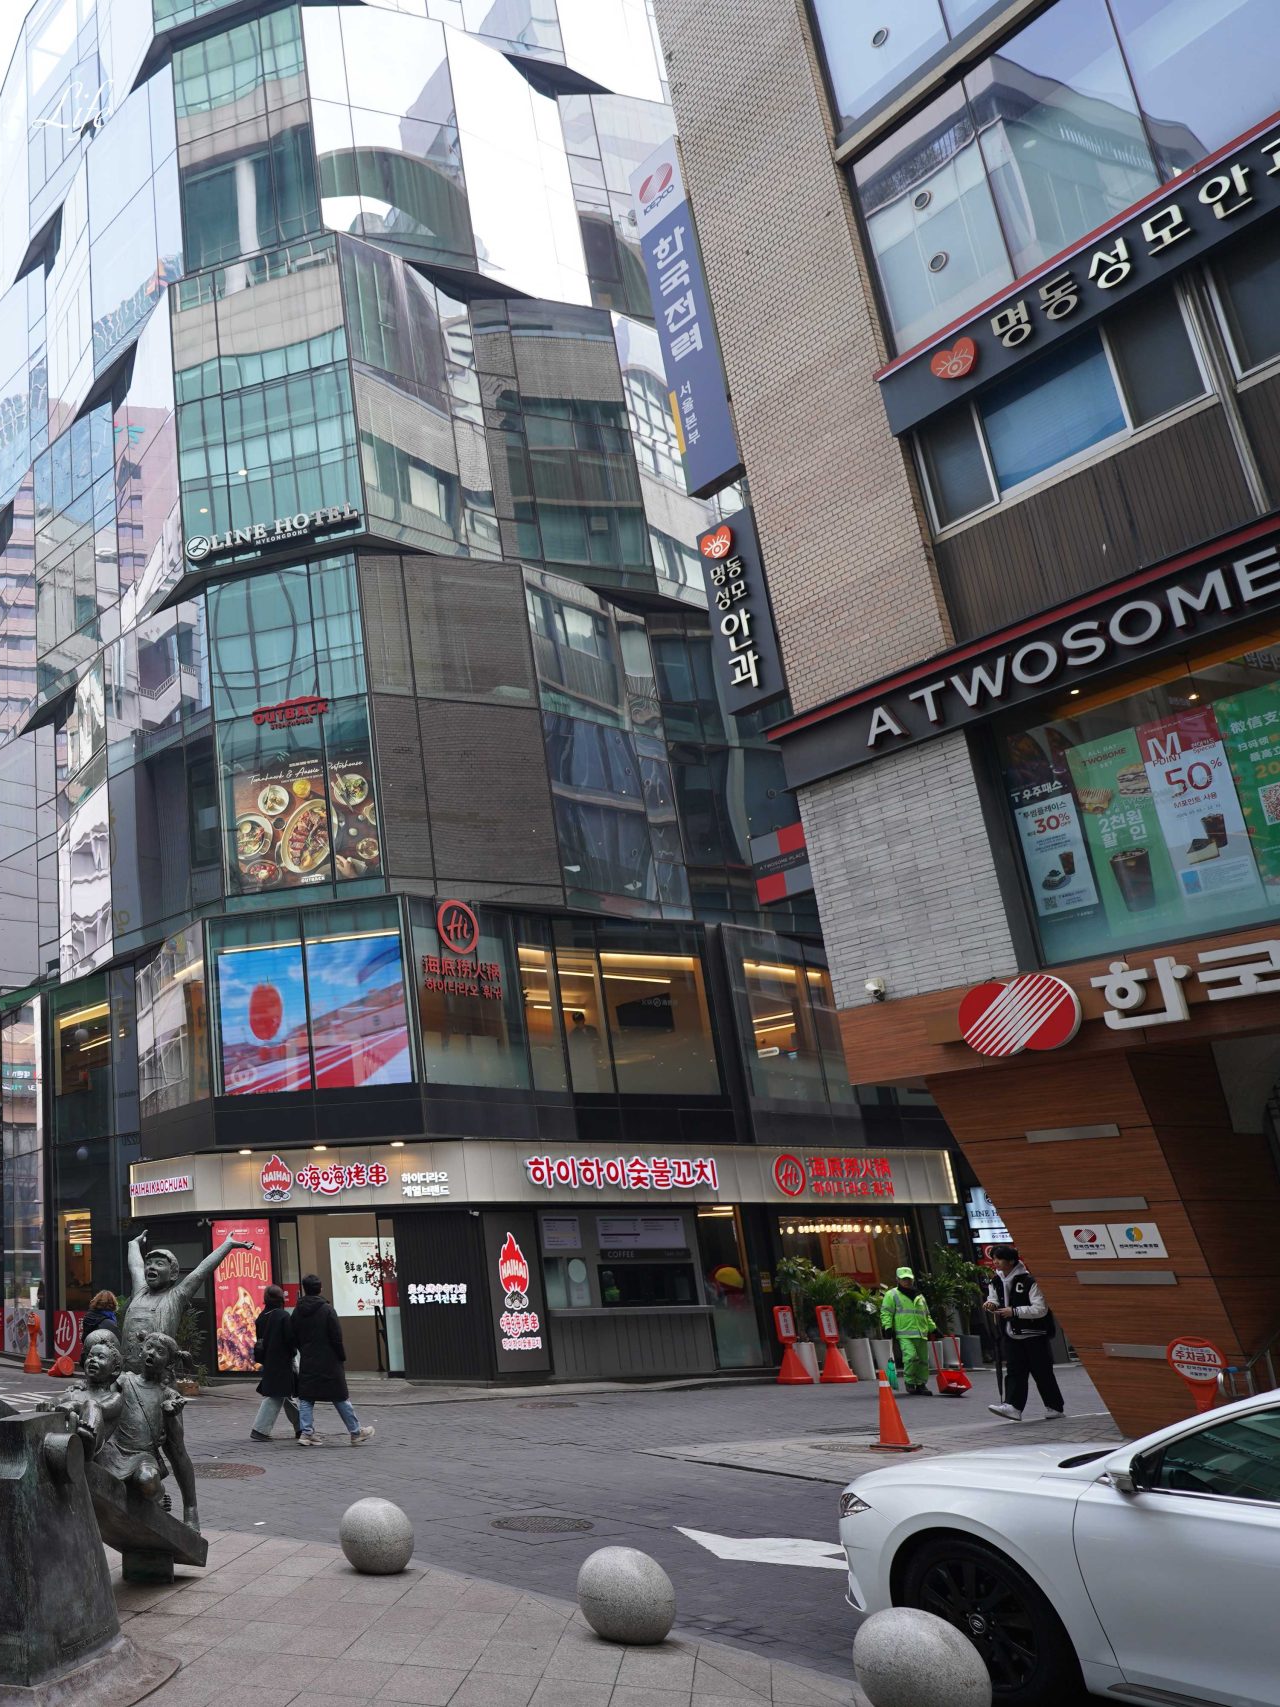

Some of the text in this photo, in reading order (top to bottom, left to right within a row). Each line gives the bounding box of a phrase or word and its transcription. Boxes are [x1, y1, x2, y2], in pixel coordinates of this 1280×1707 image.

[643, 183, 675, 217] KEPCO
[652, 224, 703, 362] 한국전력
[677, 380, 701, 445] 서울본부
[210, 502, 358, 551] LINE HOTEL
[709, 555, 742, 586] 명동
[715, 580, 748, 611] 성모
[866, 545, 1280, 748] A TWOSOME
[252, 701, 329, 727] OUTBACK
[1082, 747, 1127, 766] TWOSOME
[263, 1171, 290, 1183] HAIHAI
[297, 1163, 388, 1191] 嗨嗨烤串
[401, 1172, 448, 1183] 하이디라오
[526, 1155, 719, 1190] 하이하이숯불꼬치
[130, 1177, 188, 1196] HAIHAIKAOCHUAN
[402, 1185, 450, 1197] 계열브랜드
[971, 1210, 990, 1218] LINE
[218, 1251, 269, 1283] HAIHAI
[607, 1250, 635, 1259] COFFEE
[502, 1258, 526, 1280] HAIHAI
[1015, 1283, 1024, 1293] C
[1176, 1350, 1217, 1363] 주차금지
